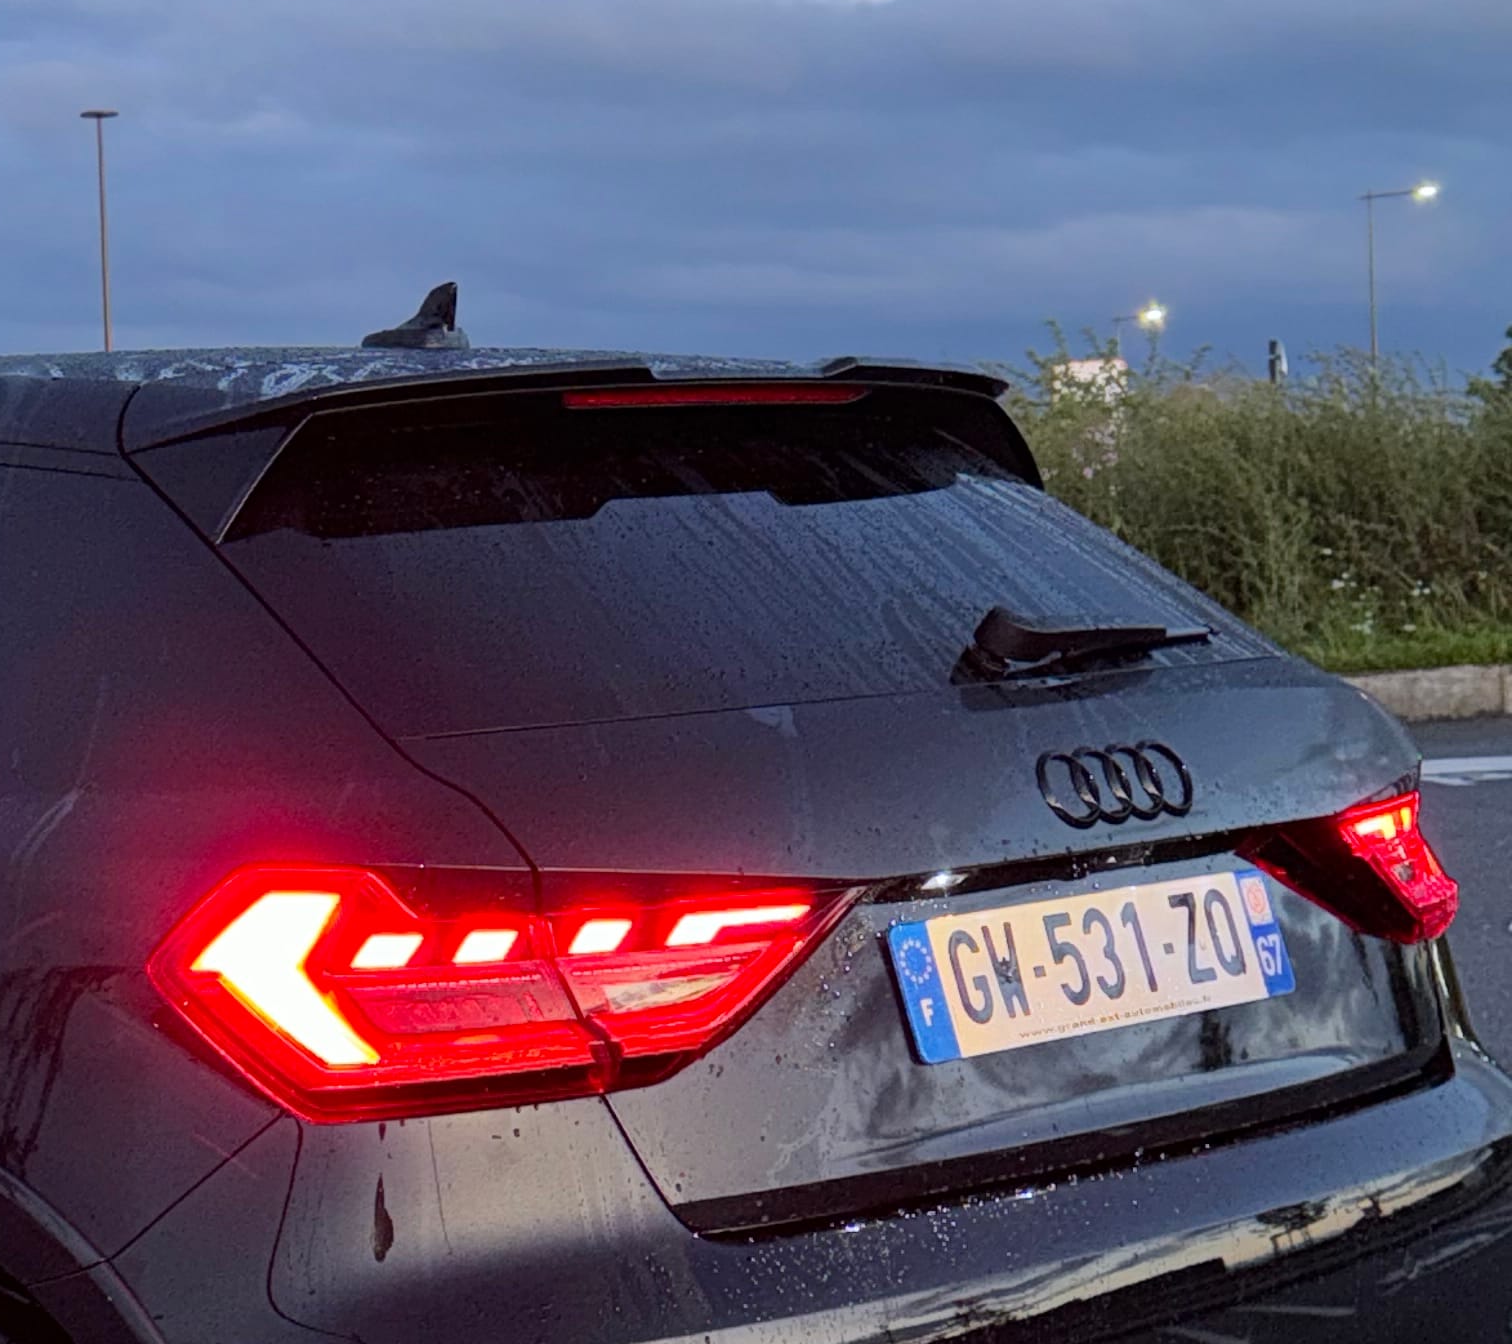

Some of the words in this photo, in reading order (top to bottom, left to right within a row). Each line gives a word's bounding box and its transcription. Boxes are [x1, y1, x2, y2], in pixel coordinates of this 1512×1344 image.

[948, 888, 1247, 1025] GW-531-ZQ
[1256, 934, 1283, 976] 67
[920, 998, 934, 1027] F
